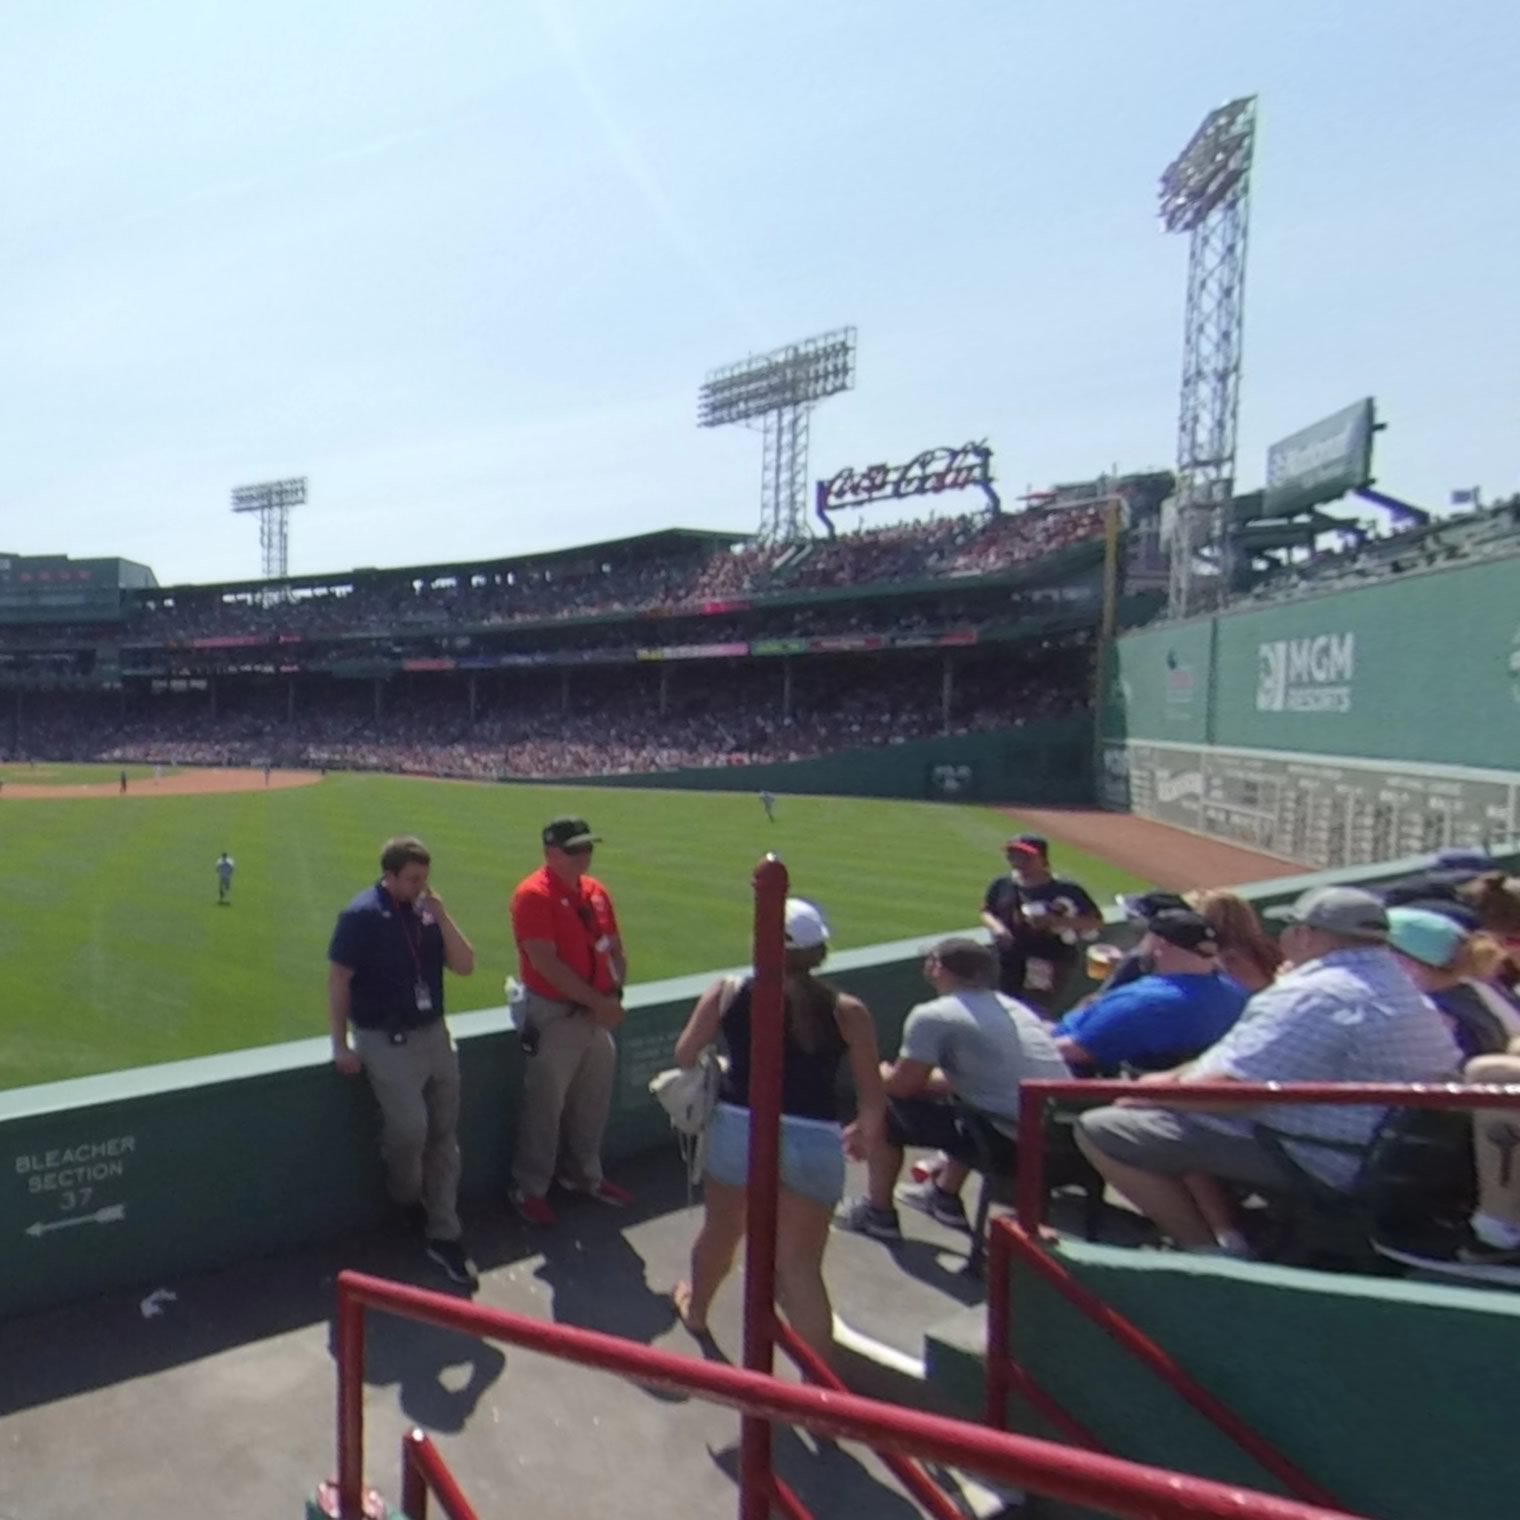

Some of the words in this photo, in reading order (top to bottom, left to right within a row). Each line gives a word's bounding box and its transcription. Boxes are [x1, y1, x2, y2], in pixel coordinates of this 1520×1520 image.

[828, 437, 988, 499] Coca-Cola
[1289, 632, 1354, 682] MGM
[1288, 687, 1350, 712] RESORTS
[16, 1135, 135, 1174] BLEACHER
[29, 1160, 123, 1193] SECTION
[60, 1187, 93, 1210] 37
